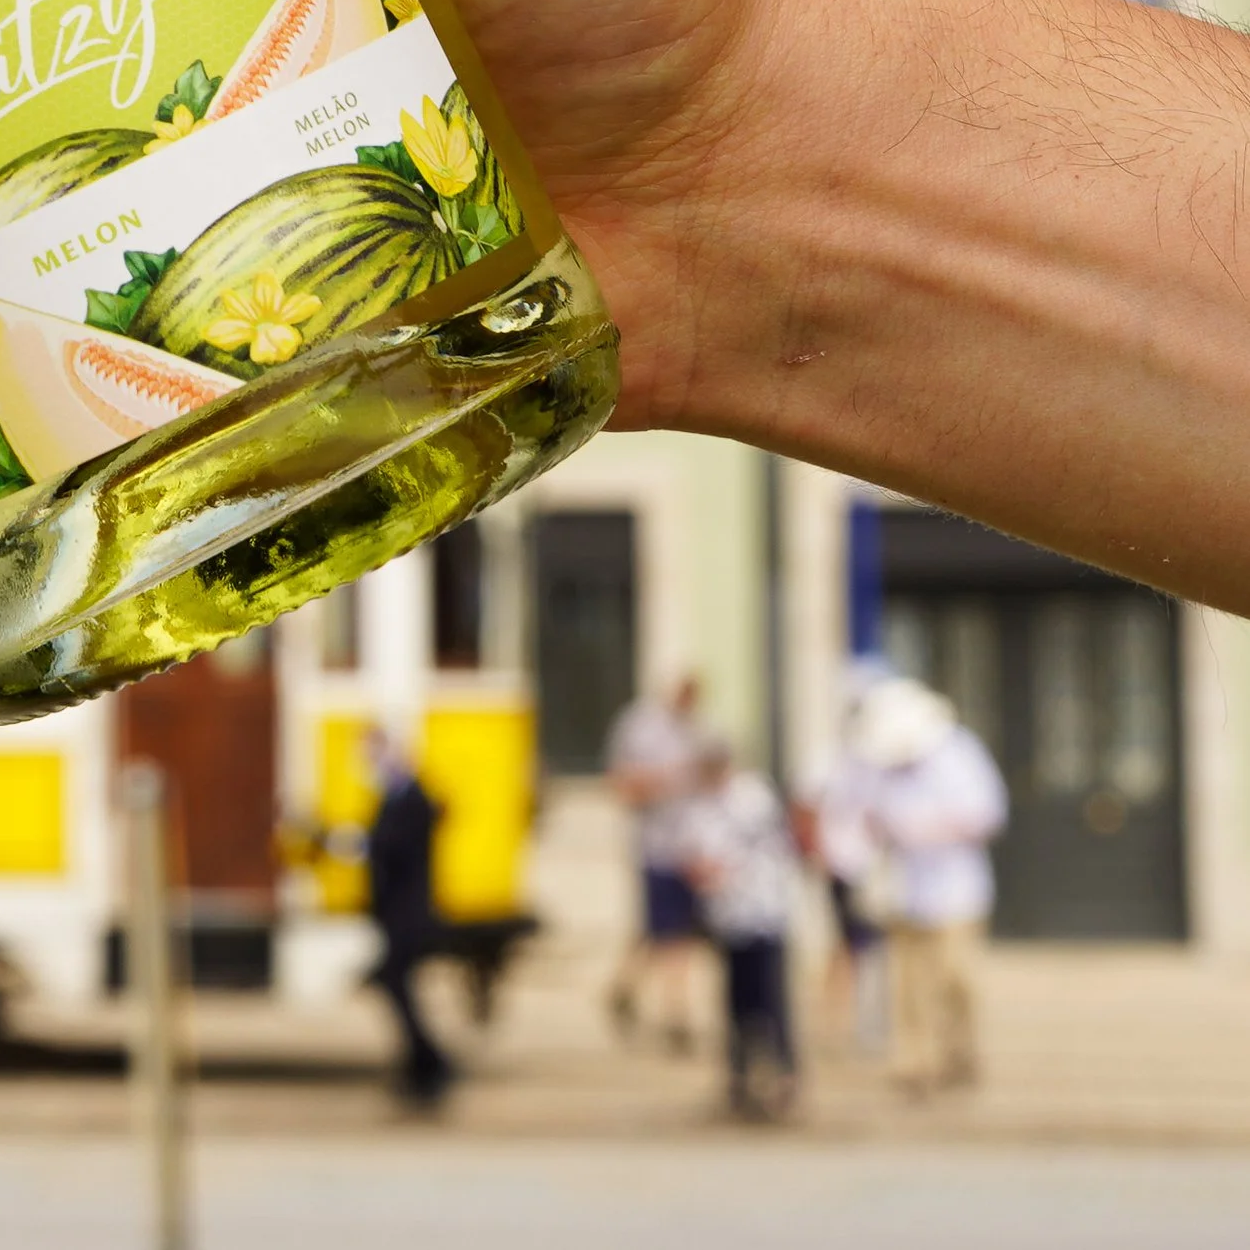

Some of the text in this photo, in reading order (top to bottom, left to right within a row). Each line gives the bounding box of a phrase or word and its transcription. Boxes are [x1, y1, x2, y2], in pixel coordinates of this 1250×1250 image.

[295, 92, 358, 135] MELÃO
[306, 112, 371, 156] MELON
[32, 209, 142, 277] MELON
